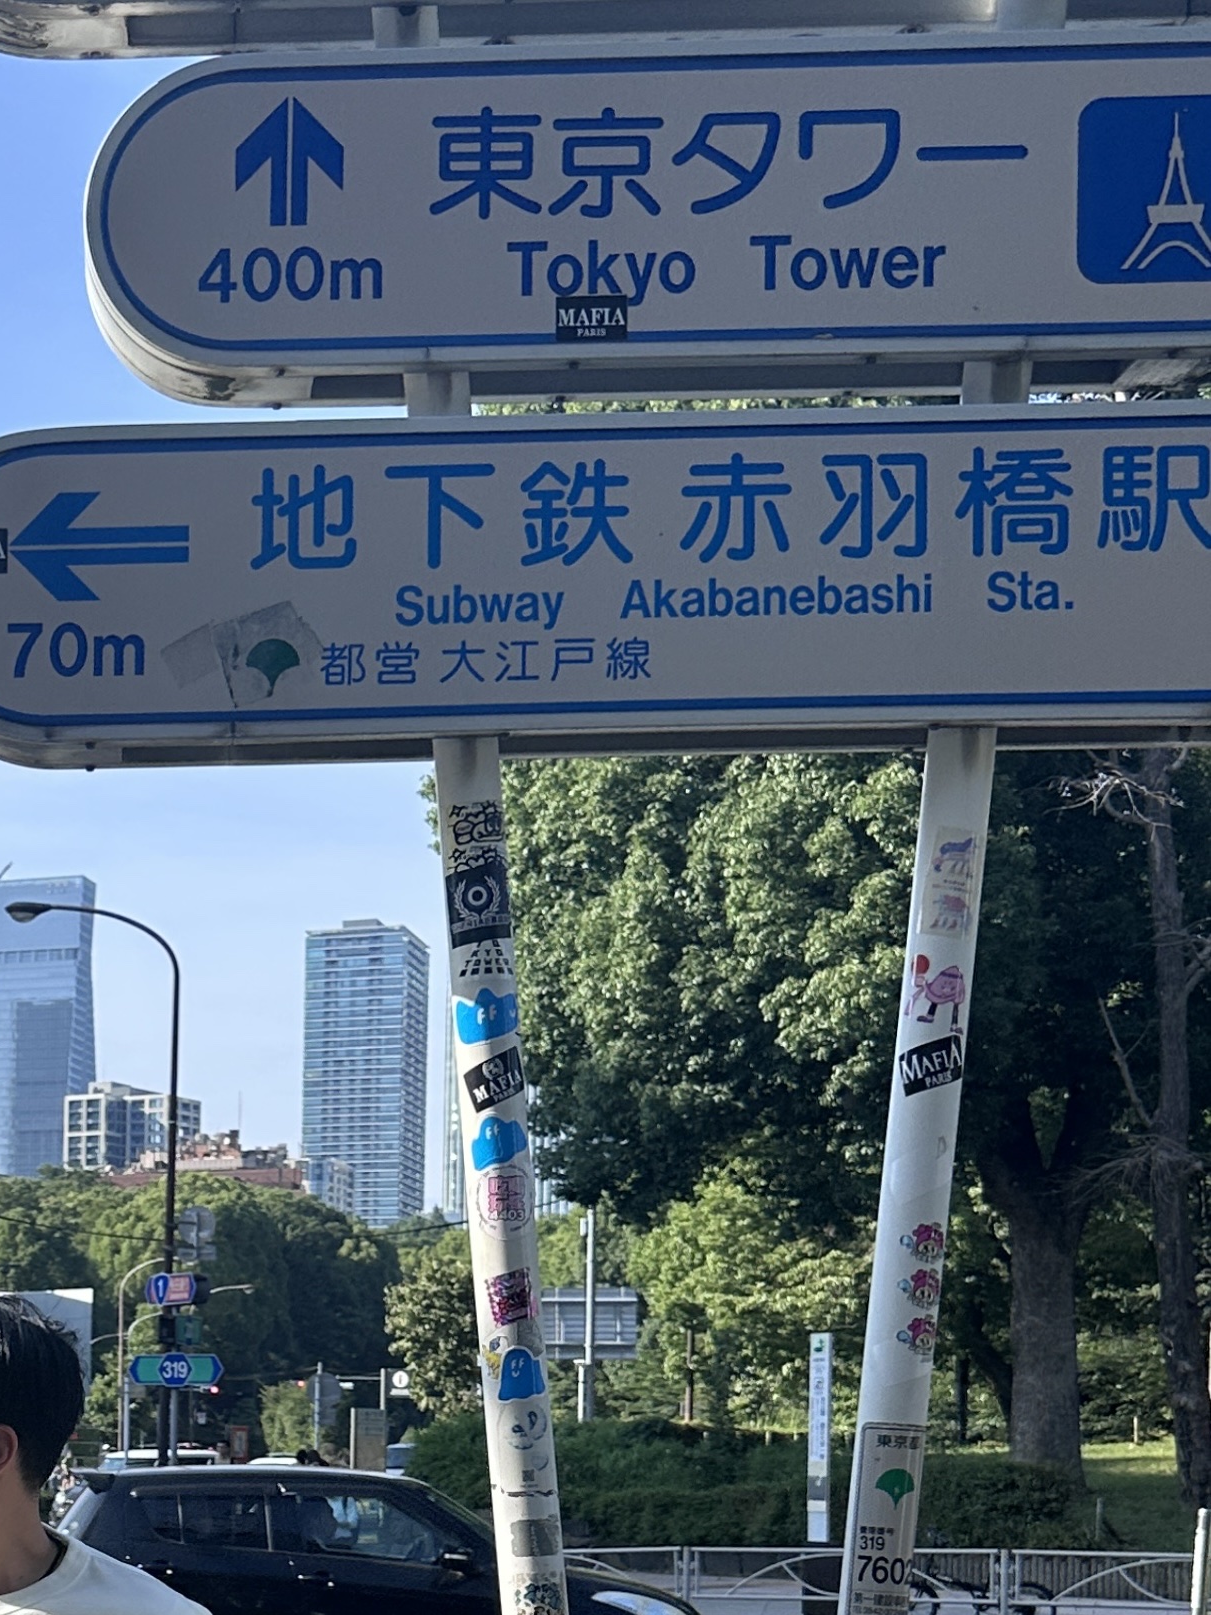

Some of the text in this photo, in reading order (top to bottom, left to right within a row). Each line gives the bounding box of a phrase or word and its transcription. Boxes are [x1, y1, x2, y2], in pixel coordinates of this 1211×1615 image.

[430, 107, 1029, 219] 東京タワー
[198, 247, 384, 304] 400m
[507, 235, 946, 307] Tokyo Tower
[557, 307, 626, 327] MAFIA
[576, 328, 607, 337] PARIS
[395, 571, 1074, 631] Subway Akabanebashi Sta.
[7, 622, 146, 679] 70m
[900, 1043, 962, 1086] MAFIA
[472, 1069, 523, 1103] MAFIA
[924, 1071, 953, 1089] PARIS
[488, 1209, 526, 1222] 4403
[157, 1279, 164, 1298] 1
[162, 1361, 188, 1379] 319
[875, 1433, 920, 1450] 東京都
[859, 1536, 886, 1551] 319
